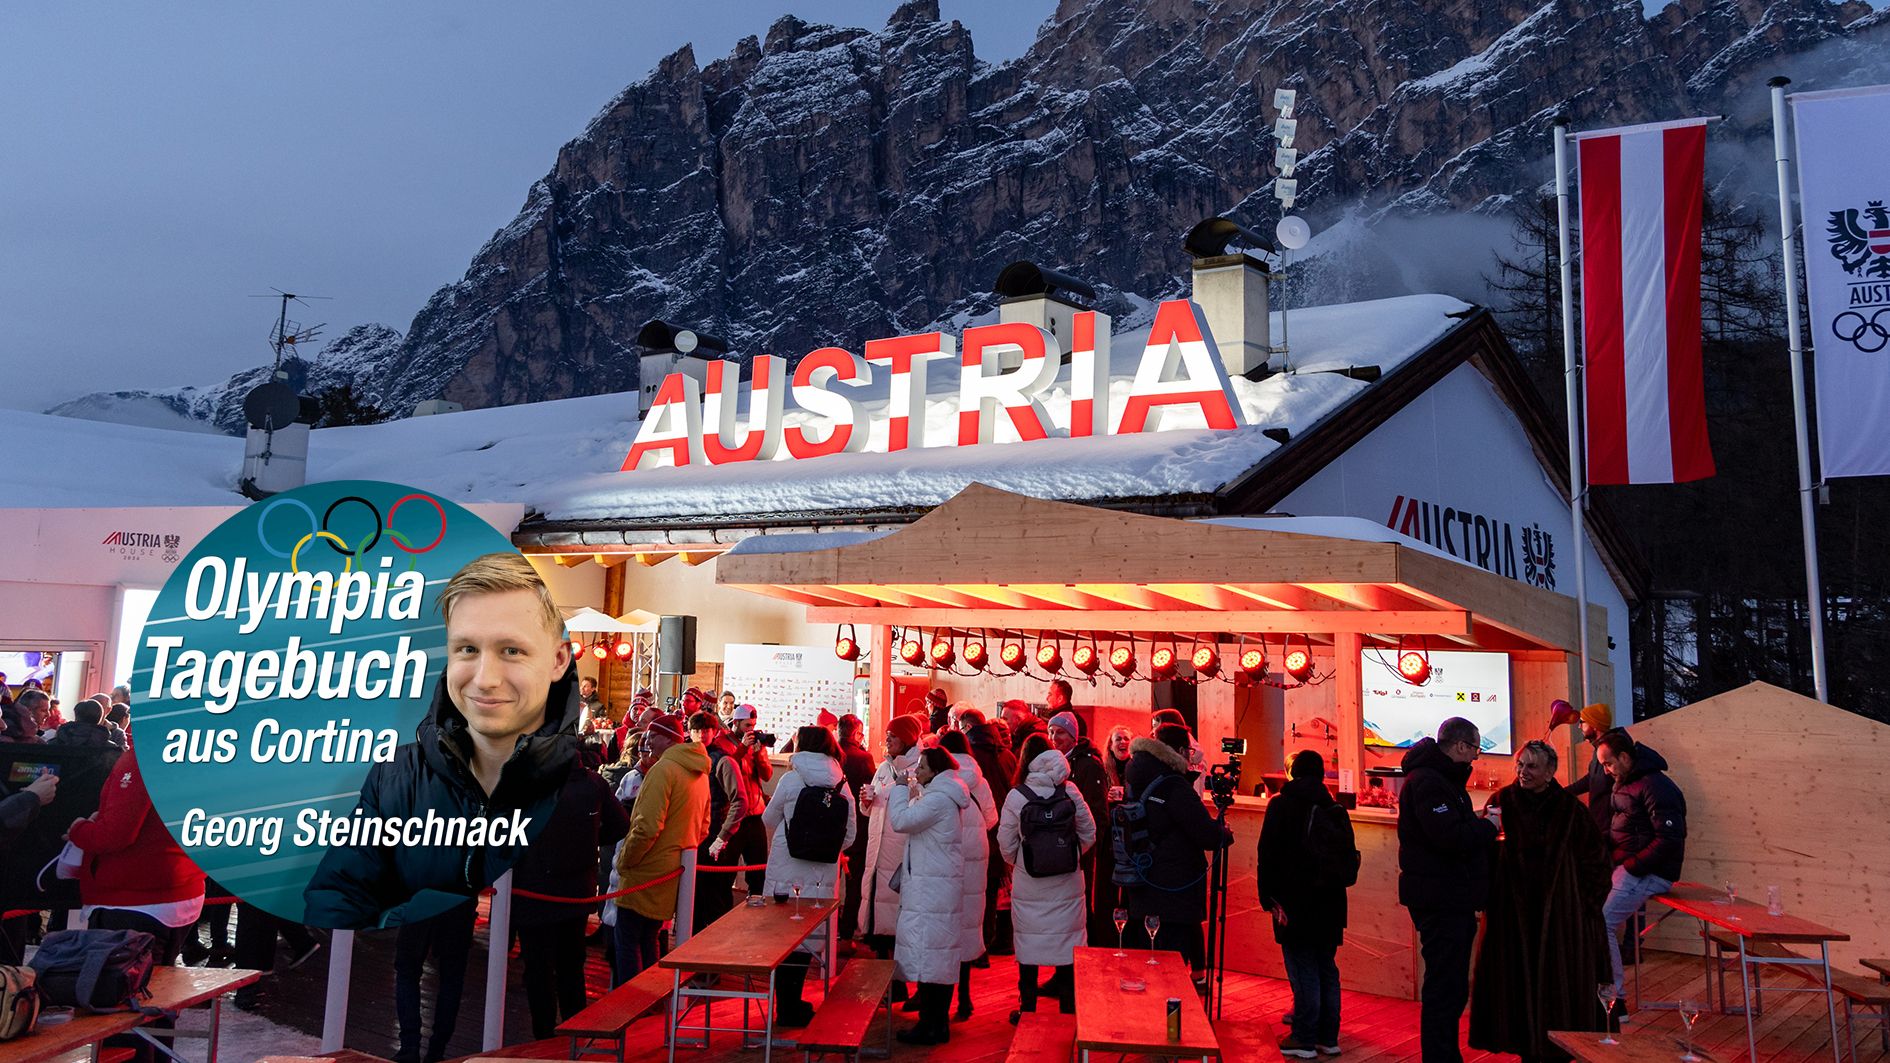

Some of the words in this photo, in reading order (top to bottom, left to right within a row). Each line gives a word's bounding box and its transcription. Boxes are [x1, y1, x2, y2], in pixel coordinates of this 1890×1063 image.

[619, 298, 1246, 472] AUSTRIA
[102, 531, 161, 548] AUSTRIA
[109, 547, 155, 556] HOUSE
